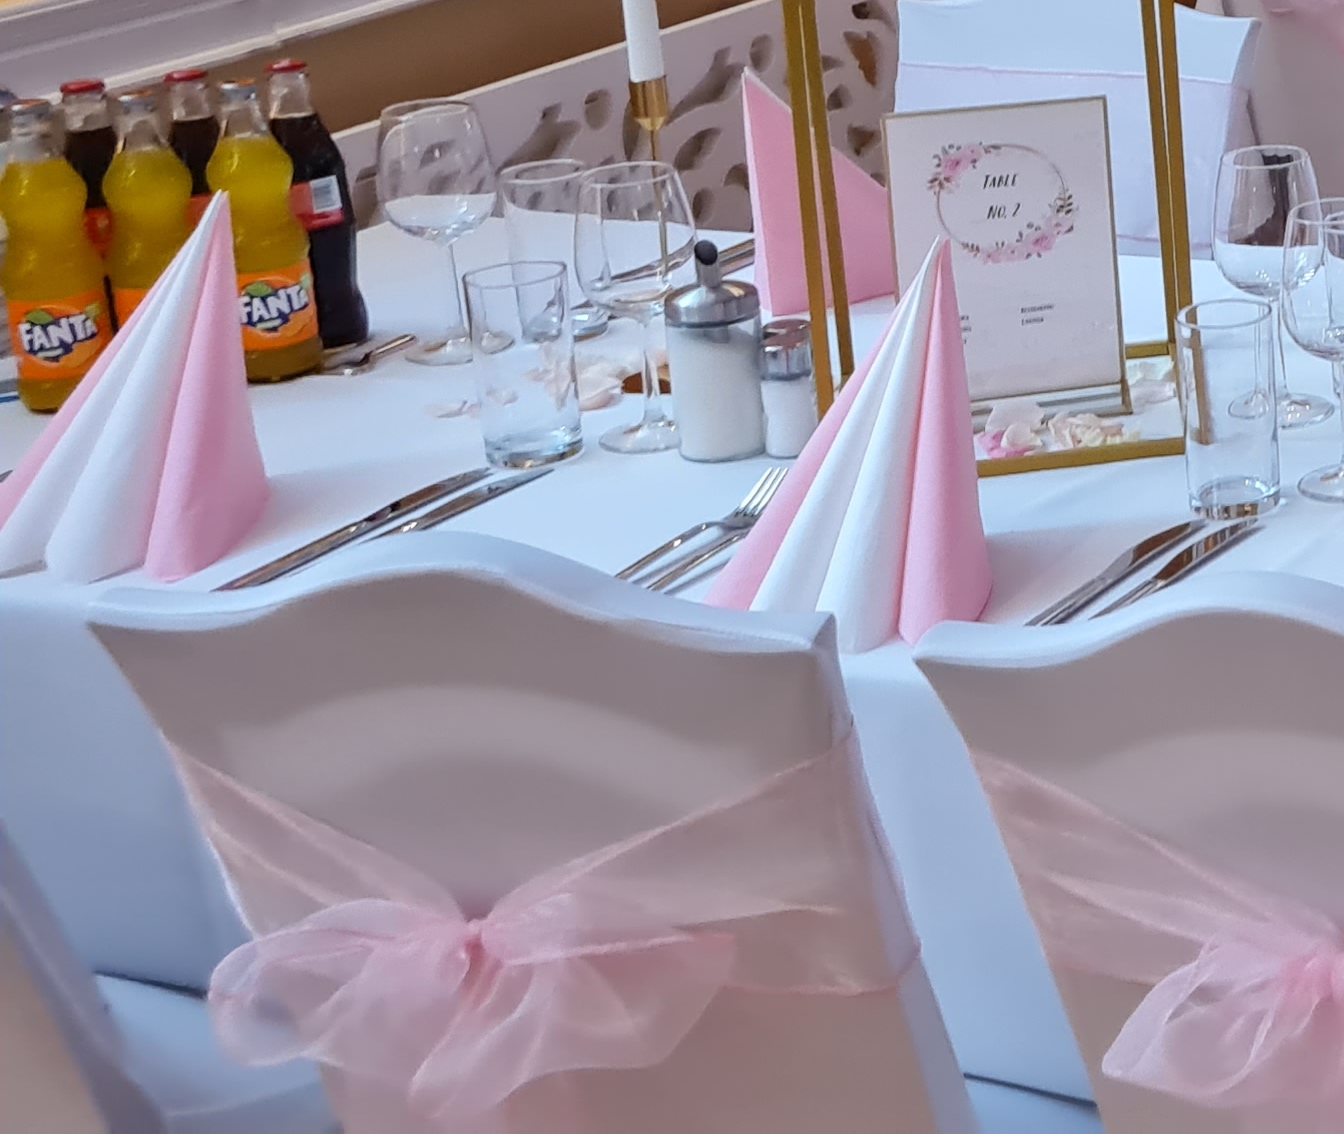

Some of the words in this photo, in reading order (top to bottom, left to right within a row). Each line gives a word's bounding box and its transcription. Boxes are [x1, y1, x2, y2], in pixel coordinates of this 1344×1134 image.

[983, 173, 1018, 189] TABLE
[987, 204, 1007, 219] NO.
[239, 284, 309, 323] FANTA
[19, 313, 98, 352] FANTA
